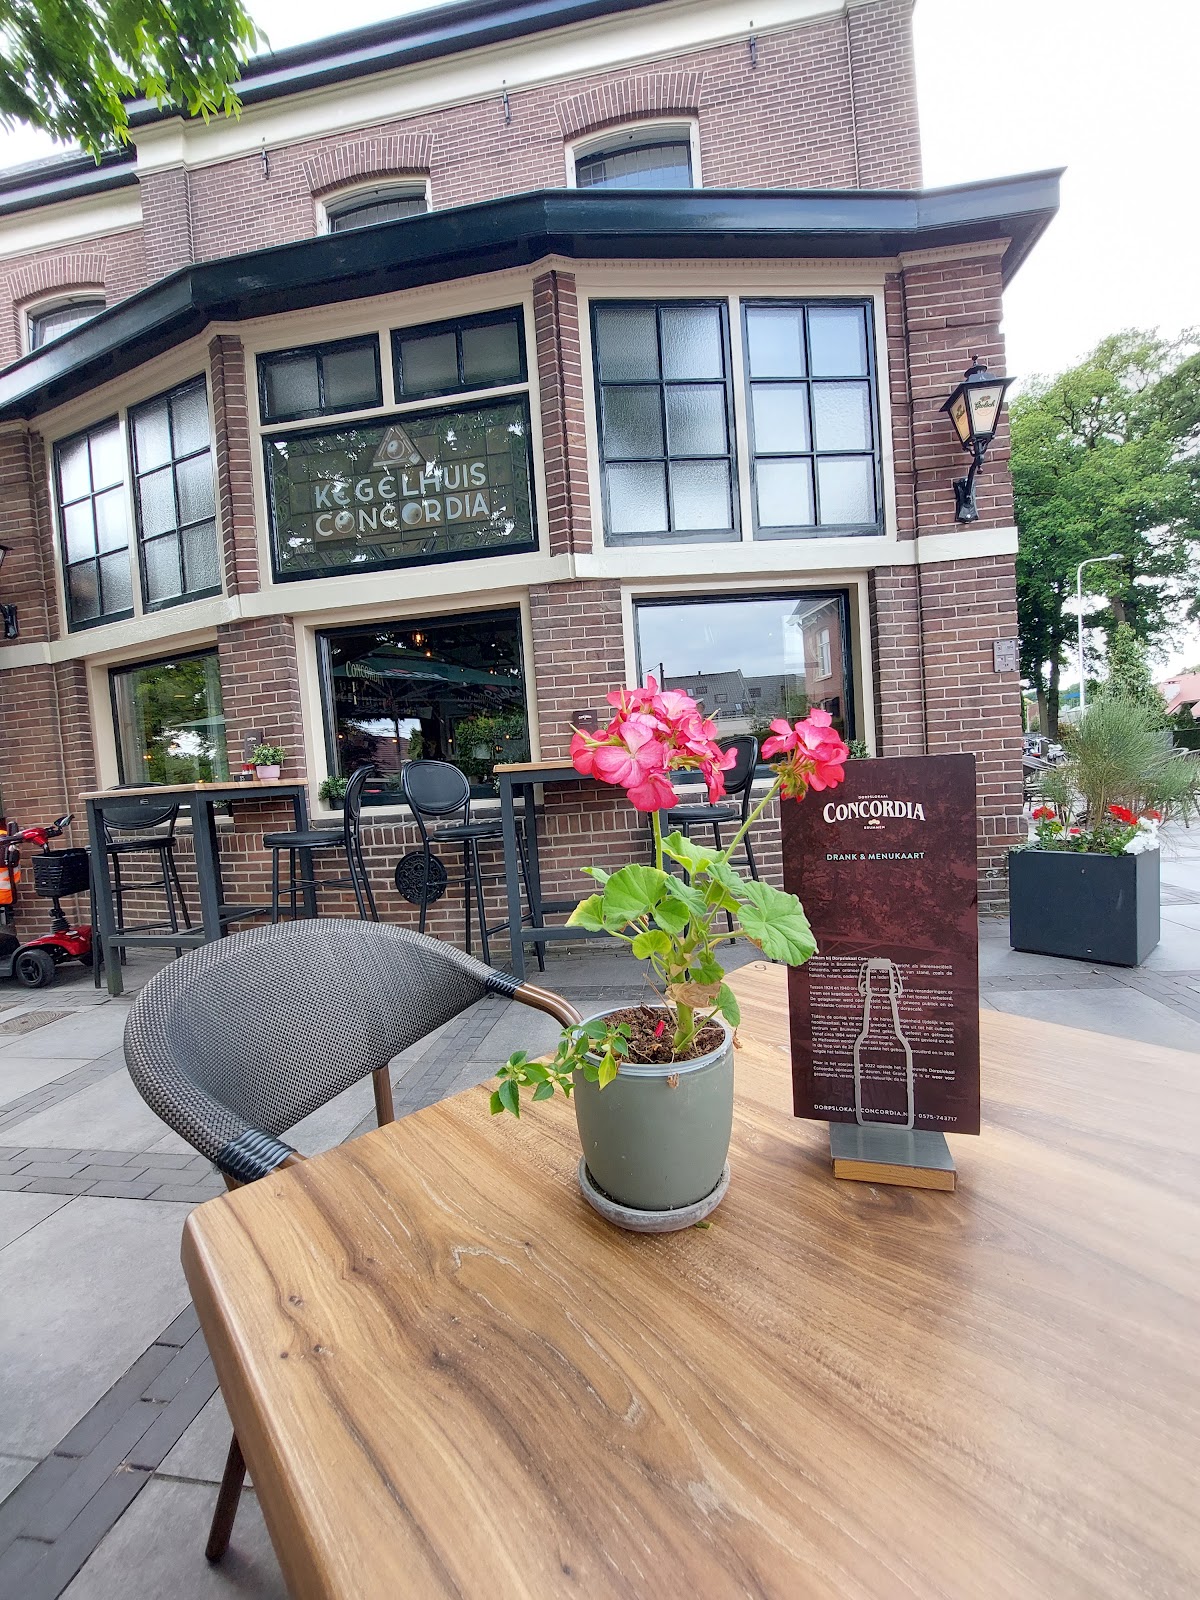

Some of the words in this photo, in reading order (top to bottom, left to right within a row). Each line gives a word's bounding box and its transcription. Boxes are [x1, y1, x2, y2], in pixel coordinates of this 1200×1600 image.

[315, 462, 486, 509] KEGELHUIS
[315, 492, 490, 538] CONCORDIA
[823, 800, 926, 823] CONCORDIA
[918, 1113, 957, 1122] 0575-743717
